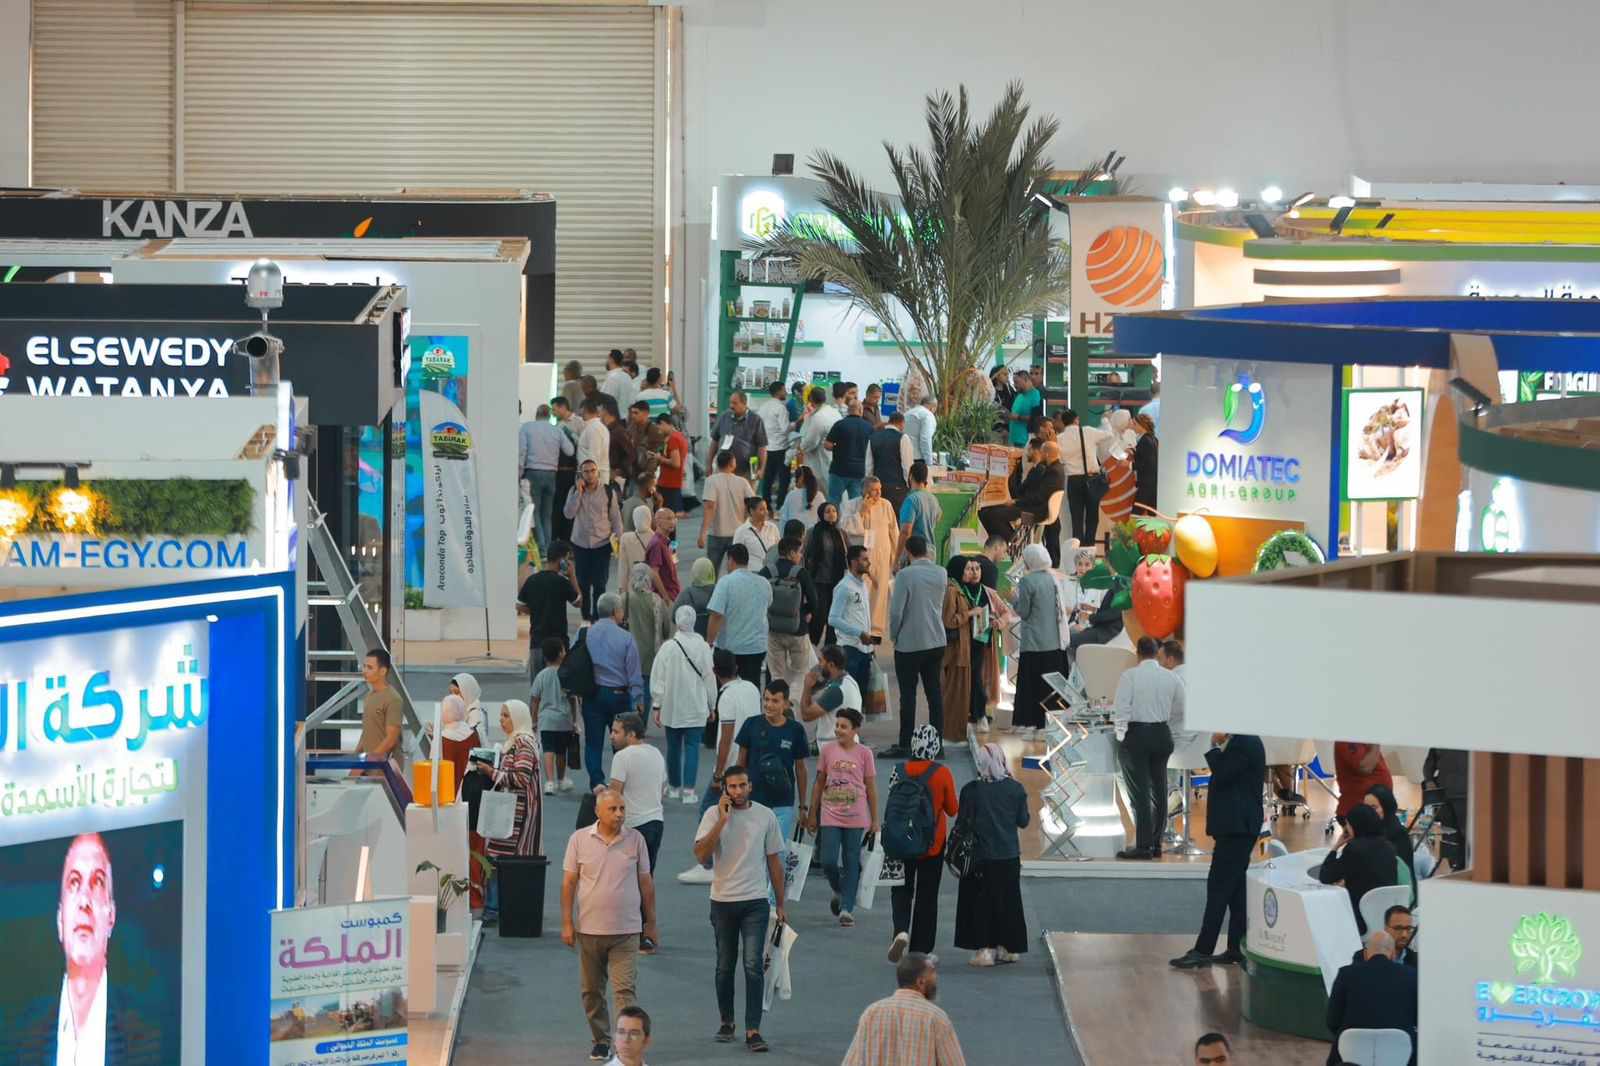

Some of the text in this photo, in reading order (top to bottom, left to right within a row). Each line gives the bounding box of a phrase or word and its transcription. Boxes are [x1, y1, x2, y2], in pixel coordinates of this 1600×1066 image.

[102, 199, 253, 237] KANZA
[26, 336, 234, 366] ELSEWEDY
[26, 376, 229, 397] WATANYA
[1186, 452, 1299, 483] DOMIATEC
[437, 530, 447, 546] Top
[43, 643, 209, 751] شركة
[341, 912, 402, 928] كمبوست
[278, 928, 402, 968] الملكة
